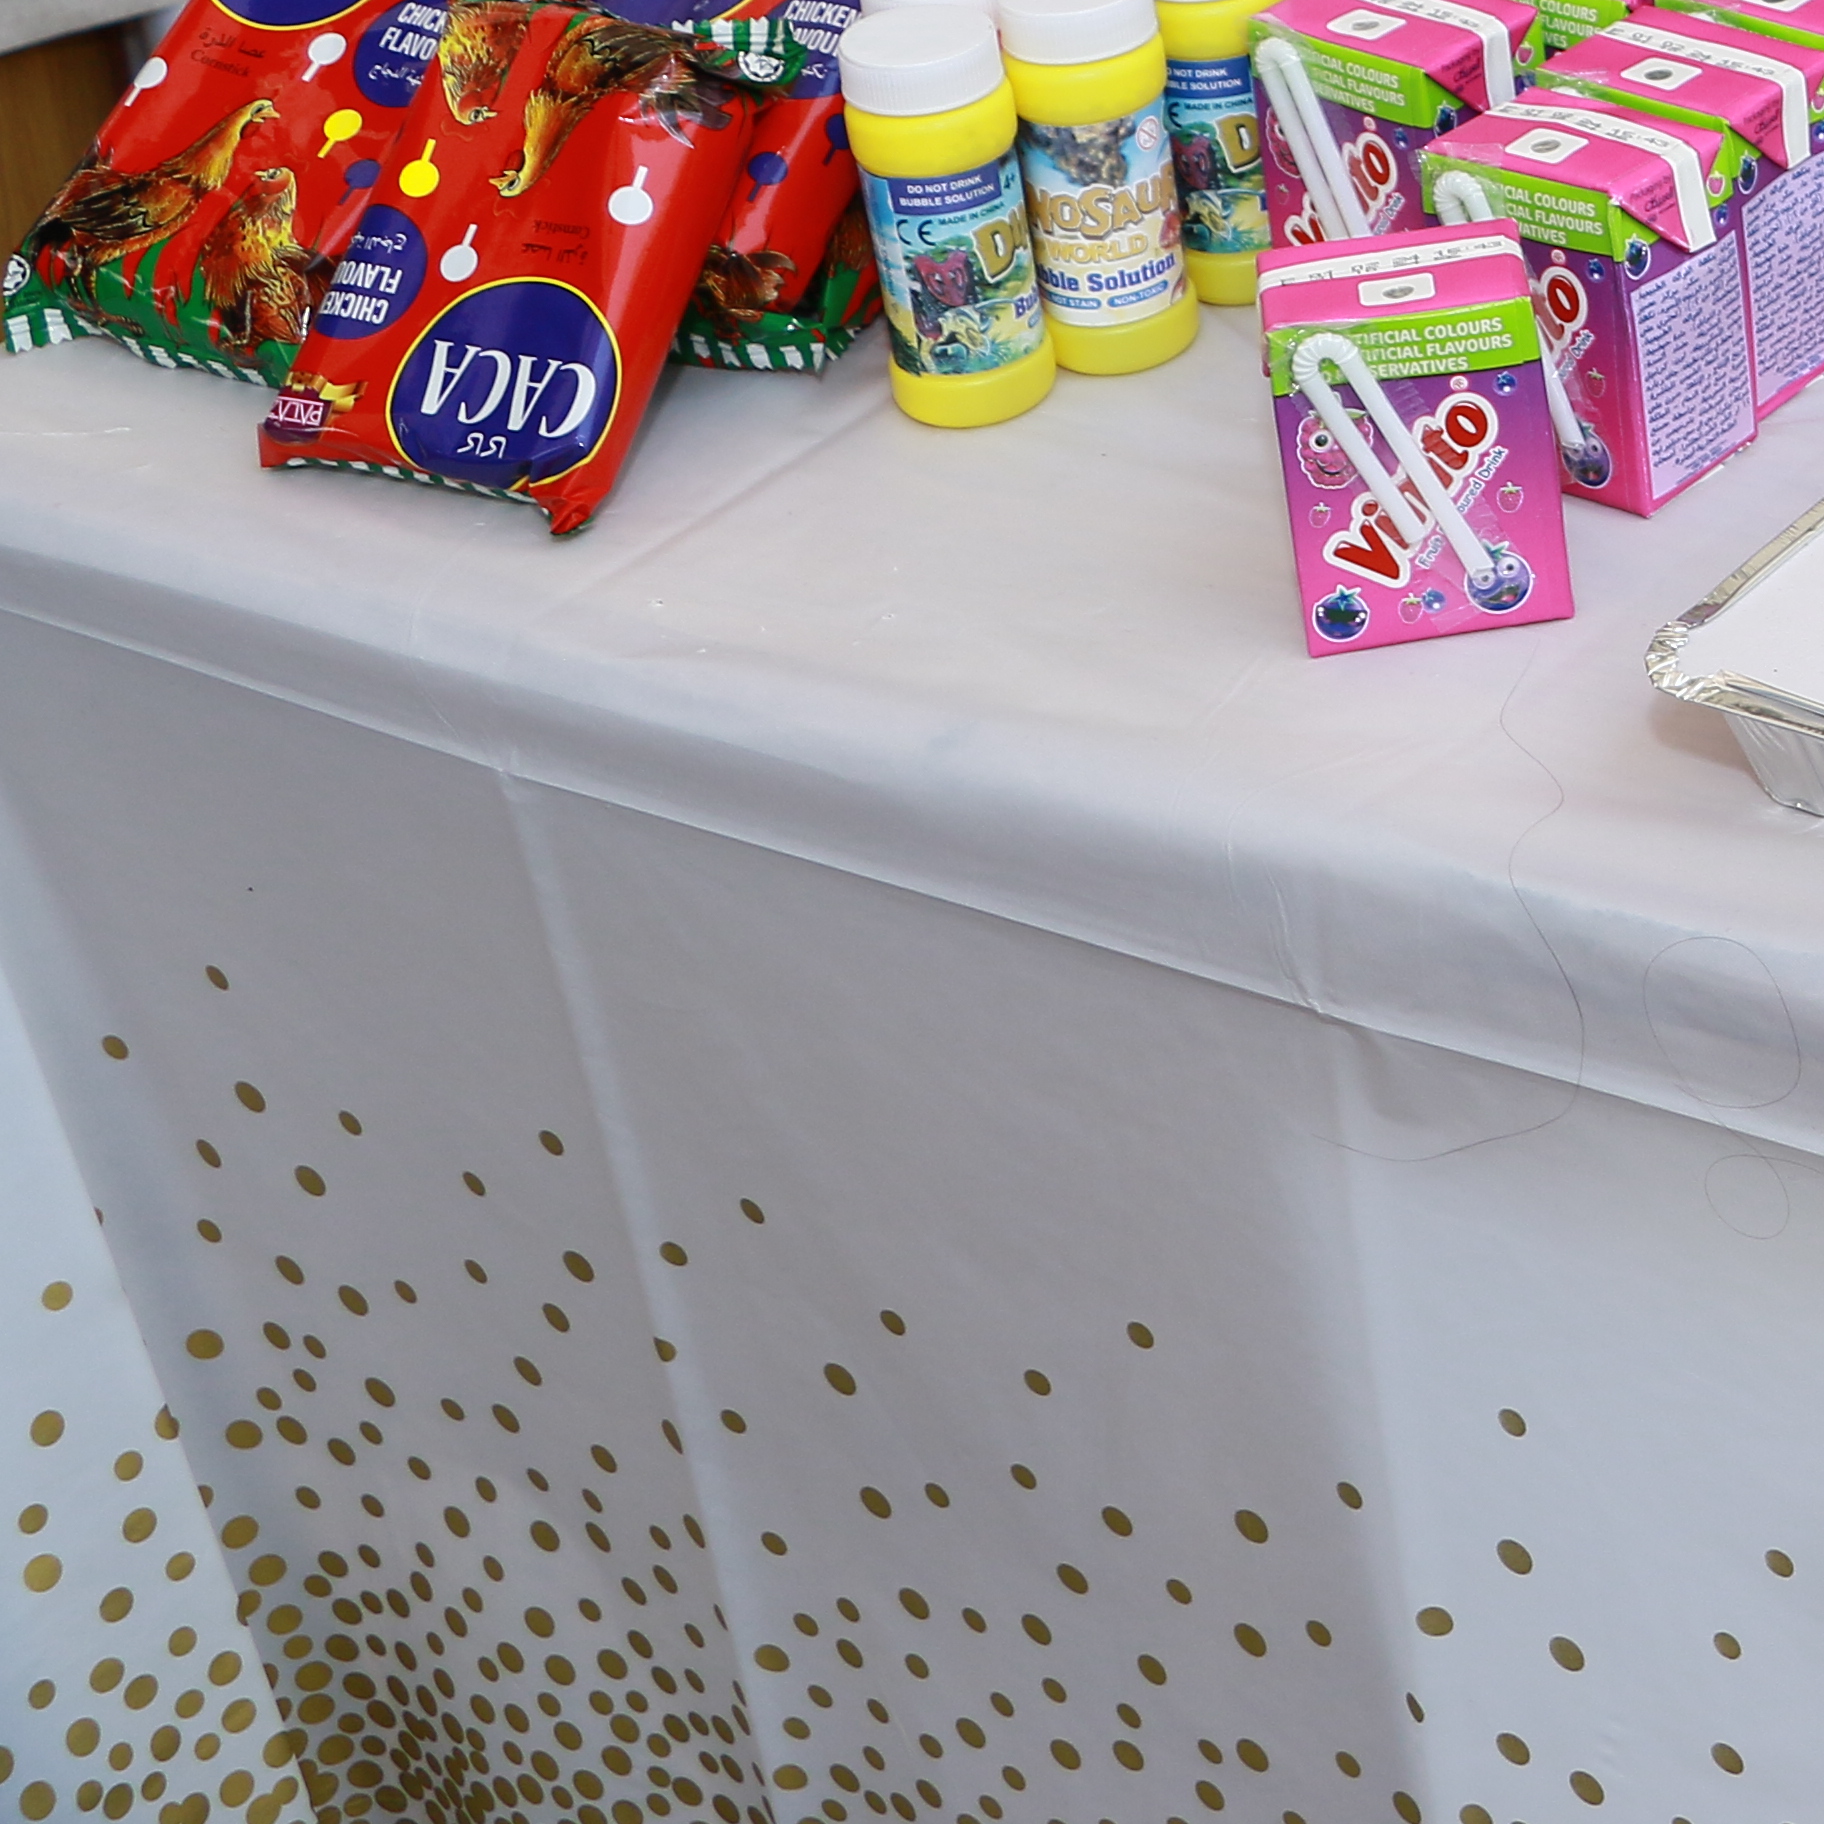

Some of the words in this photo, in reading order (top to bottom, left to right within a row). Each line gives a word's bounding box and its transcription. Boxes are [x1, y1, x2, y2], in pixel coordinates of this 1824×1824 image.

[398, 2, 449, 34] CHICK
[379, 26, 438, 61] FLAVO
[1173, 68, 1194, 78] NOT
[1195, 67, 1229, 78] DRINK
[1190, 78, 1243, 91] SOLUTION
[1345, 62, 1400, 89] COLOURS
[1183, 101, 1211, 111] MADE
[1212, 101, 1223, 110] IN
[1224, 98, 1255, 110] CHINA
[1347, 78, 1406, 107] FLAVOURS
[899, 196, 943, 207] BUBBLE
[944, 183, 995, 205] SOLUTION
[906, 184, 924, 194] DO
[925, 182, 948, 194] NOT
[949, 174, 983, 190] DRINK
[937, 214, 967, 226] MADE
[968, 212, 980, 221] IN
[980, 202, 1007, 218] CHINA
[1534, 194, 1596, 218] COLOURS
[1535, 209, 1604, 236] FLAVOURS
[1051, 233, 1149, 264] WORLD
[331, 259, 403, 295] FLAVOU
[1086, 252, 1176, 293] Solution
[1069, 297, 1098, 308] STAIN
[1113, 282, 1166, 307] NON-TOXIC
[319, 294, 390, 325] CHICKE
[1424, 317, 1503, 342] COLOURS
[1426, 333, 1513, 357] FLAVOURS
[420, 338, 597, 439] CACA
[1478, 448, 1506, 479] Drink
